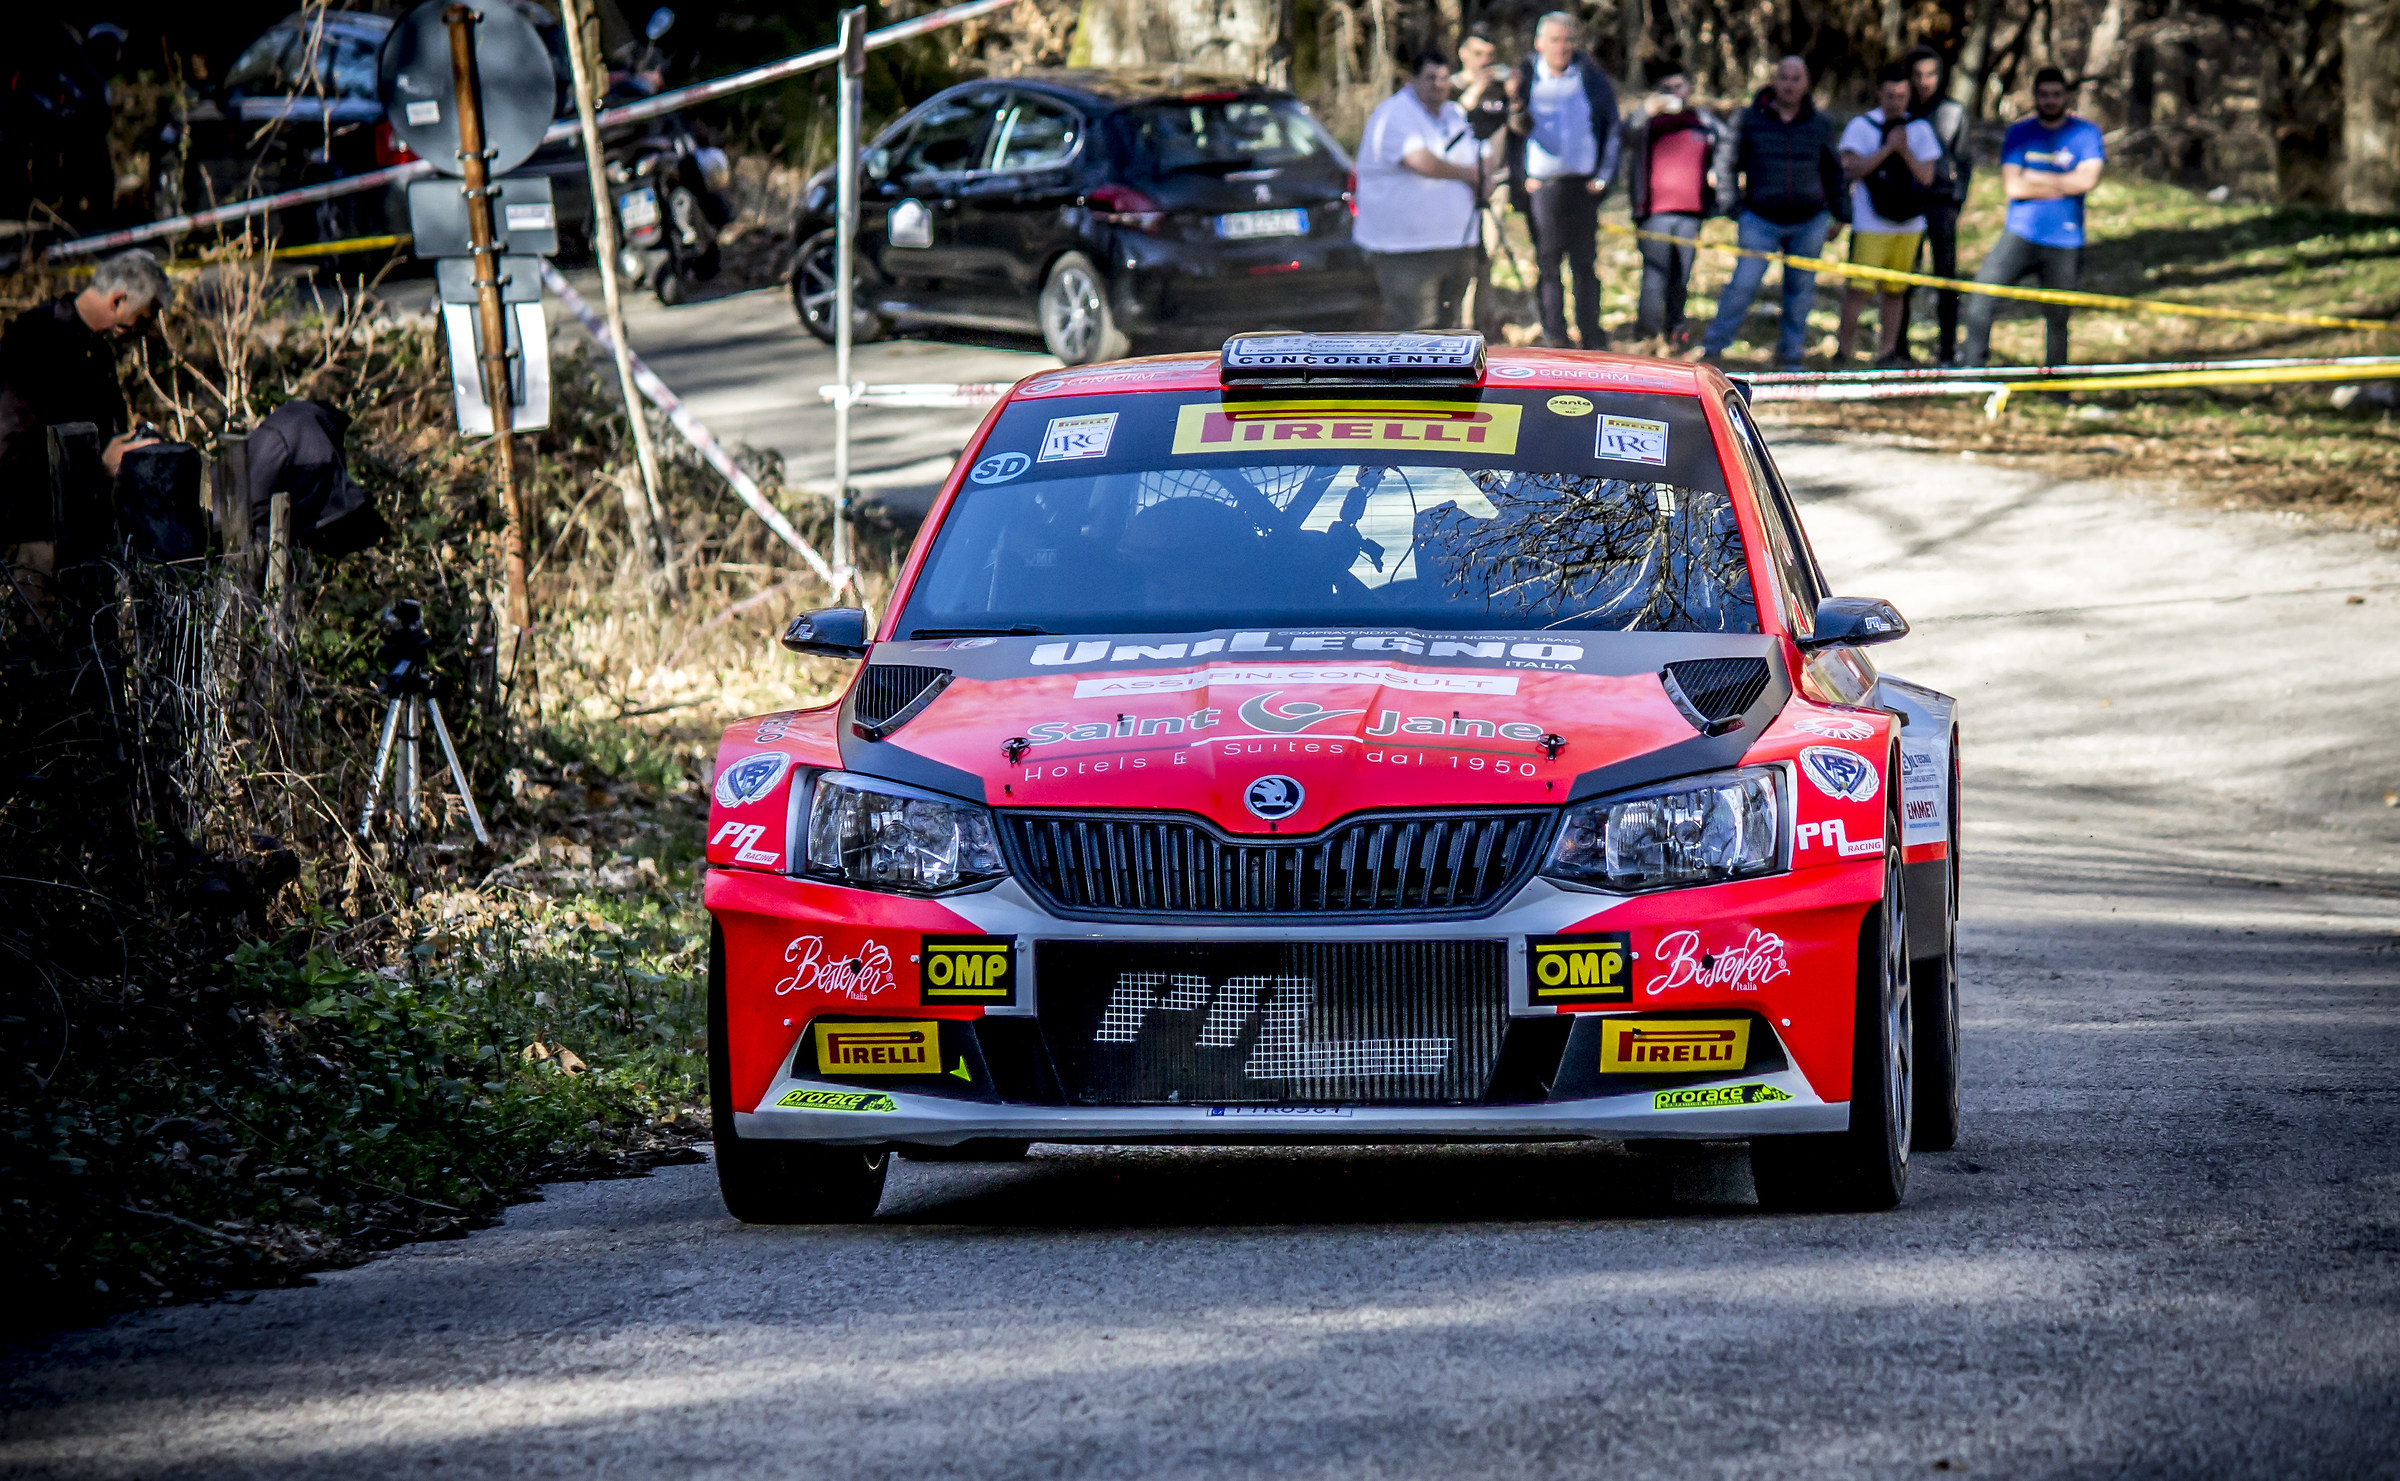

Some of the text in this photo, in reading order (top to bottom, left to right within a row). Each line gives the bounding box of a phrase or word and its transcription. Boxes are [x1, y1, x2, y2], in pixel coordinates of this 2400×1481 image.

[1238, 355, 1463, 365] CONCORRENTE
[1200, 409, 1493, 443] PIRELLI
[975, 457, 1026, 480] SD
[1405, 631, 1457, 640] PALLETS
[1505, 660, 1577, 671] ITALIA
[1026, 707, 1545, 745] Saint Jane
[1024, 756, 1147, 781] Hotels
[1223, 741, 1344, 756] Suites
[1366, 750, 1424, 765] dal
[1451, 756, 1537, 776] 1950
[1906, 800, 1938, 820] EMMETI
[744, 852, 775, 863] RACING
[1847, 841, 1881, 853] RACING
[927, 954, 1008, 987] OMP
[1536, 951, 1623, 986] OMP
[850, 992, 868, 1000] Italia
[1736, 982, 1757, 991] Italia
[827, 1032, 925, 1064] PIRELLI
[1617, 1030, 1736, 1062] PIRELLI
[779, 1090, 865, 1107] prorace
[1656, 1087, 1743, 1109] prorace
